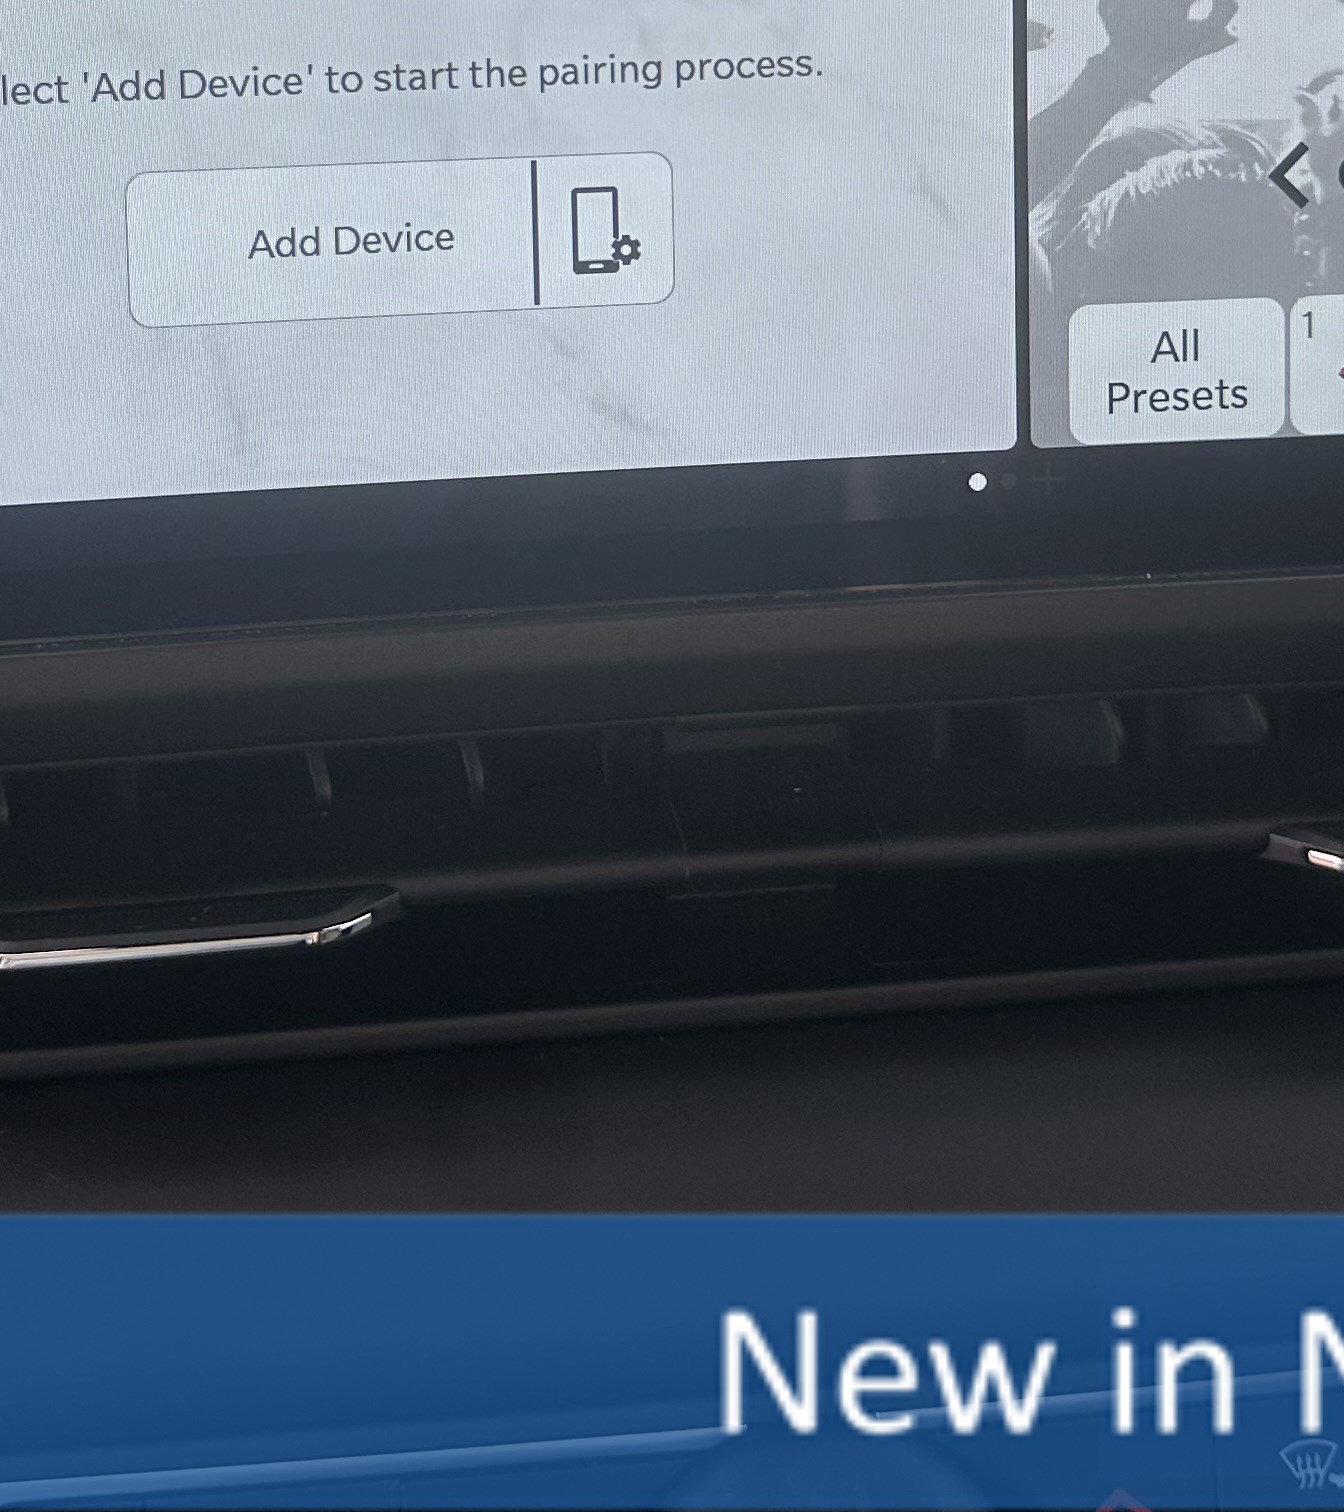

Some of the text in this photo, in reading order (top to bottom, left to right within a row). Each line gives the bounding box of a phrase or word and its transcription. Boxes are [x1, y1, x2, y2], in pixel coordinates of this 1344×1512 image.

[83, 68, 167, 102] 'Add
[178, 64, 314, 101] Device'
[325, 65, 364, 95] to
[373, 60, 460, 92] start
[468, 56, 529, 88] the
[539, 52, 664, 92] pairing
[675, 50, 825, 88] process.
[247, 221, 456, 260] Add Device
[1302, 311, 1314, 339] 1
[1150, 328, 1201, 364] All
[1107, 377, 1249, 416] Presets
